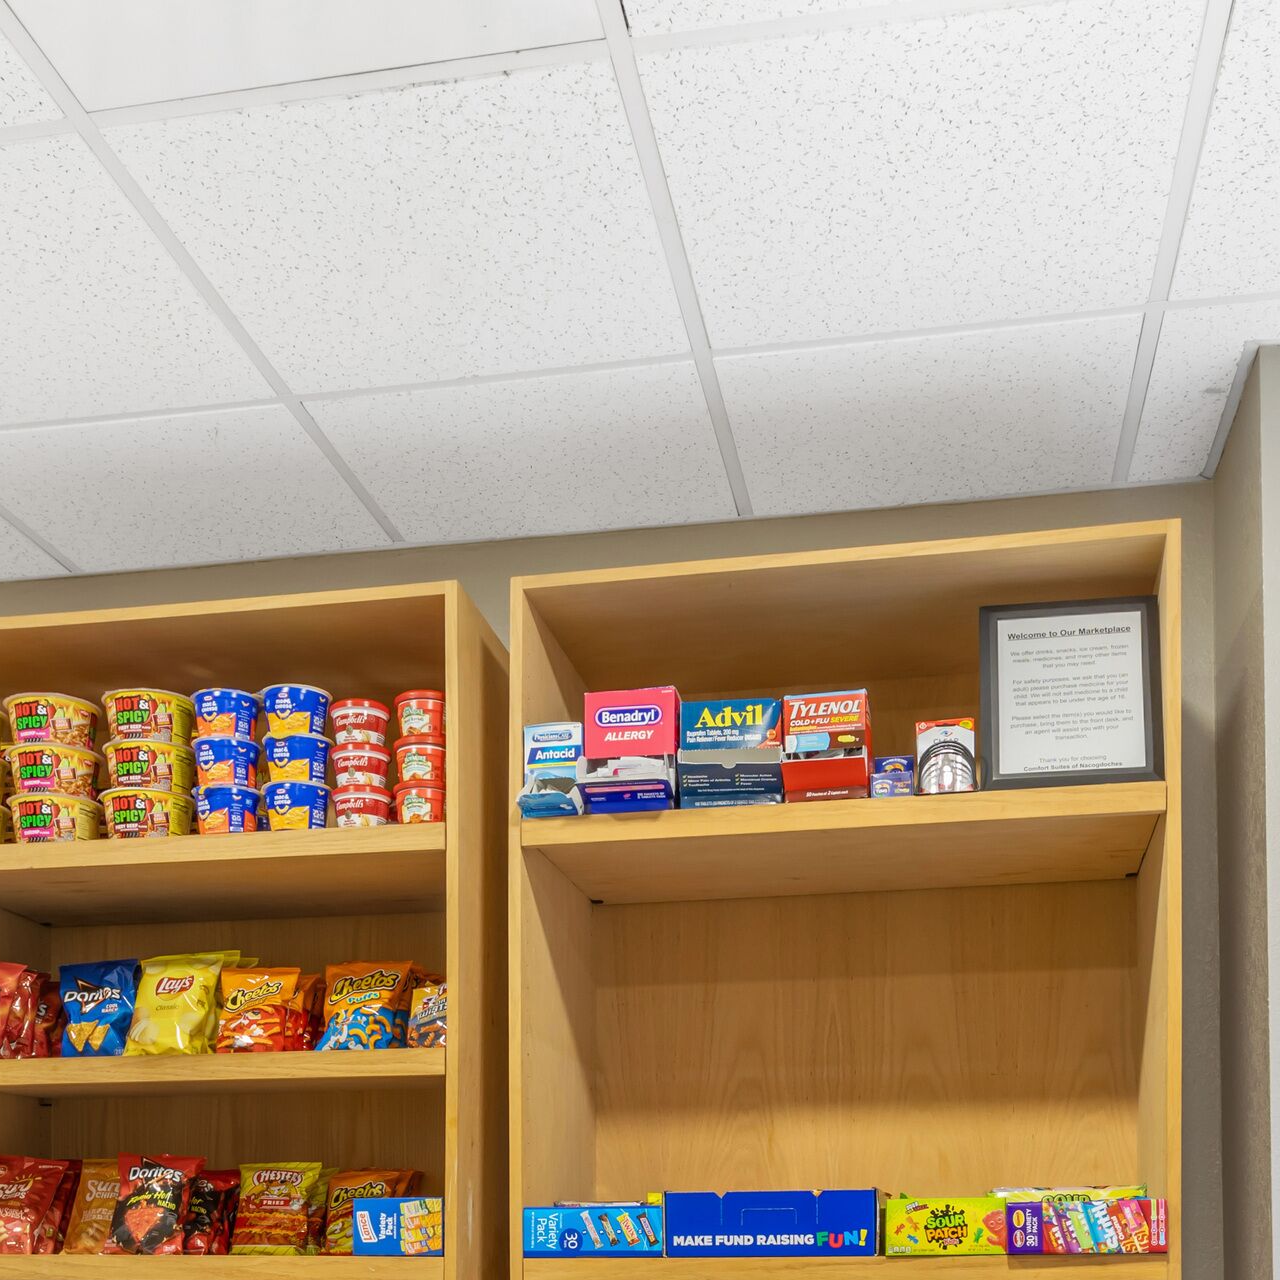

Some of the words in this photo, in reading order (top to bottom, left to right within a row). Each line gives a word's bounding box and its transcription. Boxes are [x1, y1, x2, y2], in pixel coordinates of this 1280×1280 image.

[1007, 632, 1047, 640] Welcome
[1060, 629, 1076, 637] Our
[1078, 625, 1131, 636] Marketplace
[14, 701, 38, 717] HOT
[114, 695, 141, 711] HOT
[789, 699, 863, 720] TYLENOL
[16, 714, 50, 731] SPICY
[116, 708, 150, 725] SPICY
[335, 714, 367, 727] Campbell's
[601, 709, 656, 725] Benadryl
[694, 704, 763, 728] Advil
[790, 718, 810, 727] COLD
[830, 714, 859, 723] SEVERE
[604, 729, 654, 742] ALLERGY
[19, 750, 44, 768] HOT
[114, 747, 140, 764] HOT
[337, 756, 369, 768] Campbell's
[535, 748, 575, 761] Antacid
[20, 764, 53, 781] SPICY
[116, 760, 149, 776] SPICY
[1079, 761, 1123, 769] Nacogdoches
[19, 799, 43, 818] HOT
[113, 796, 136, 812] HOT
[335, 799, 364, 811] Campbell's
[20, 814, 54, 829] SPICY
[113, 807, 147, 824] SPICY
[156, 975, 195, 994] Lay's
[328, 969, 402, 1005] Cheetos
[63, 985, 121, 1004] Doritos
[223, 981, 283, 1013] Cheetos
[346, 991, 381, 1004] Puffs
[155, 1003, 180, 1012] Classic
[128, 1165, 185, 1183] Doritos
[262, 1198, 286, 1206] FRIES
[329, 1182, 385, 1210] Cheetos
[156, 1199, 177, 1211] NACHO
[357, 1212, 377, 1242] Lance
[378, 1212, 388, 1241] Variety
[385, 1216, 394, 1236] Pack
[926, 1214, 965, 1229] SOUR
[536, 1218, 548, 1243] Pack
[545, 1212, 559, 1249] Variety
[672, 1234, 714, 1247] MAKE
[715, 1234, 754, 1246] FUND
[756, 1233, 815, 1246] RAISING
[816, 1228, 869, 1249] FUN!
[925, 1226, 968, 1240] PATCH
[564, 1232, 578, 1249] 30
[1026, 1235, 1035, 1247] 30
